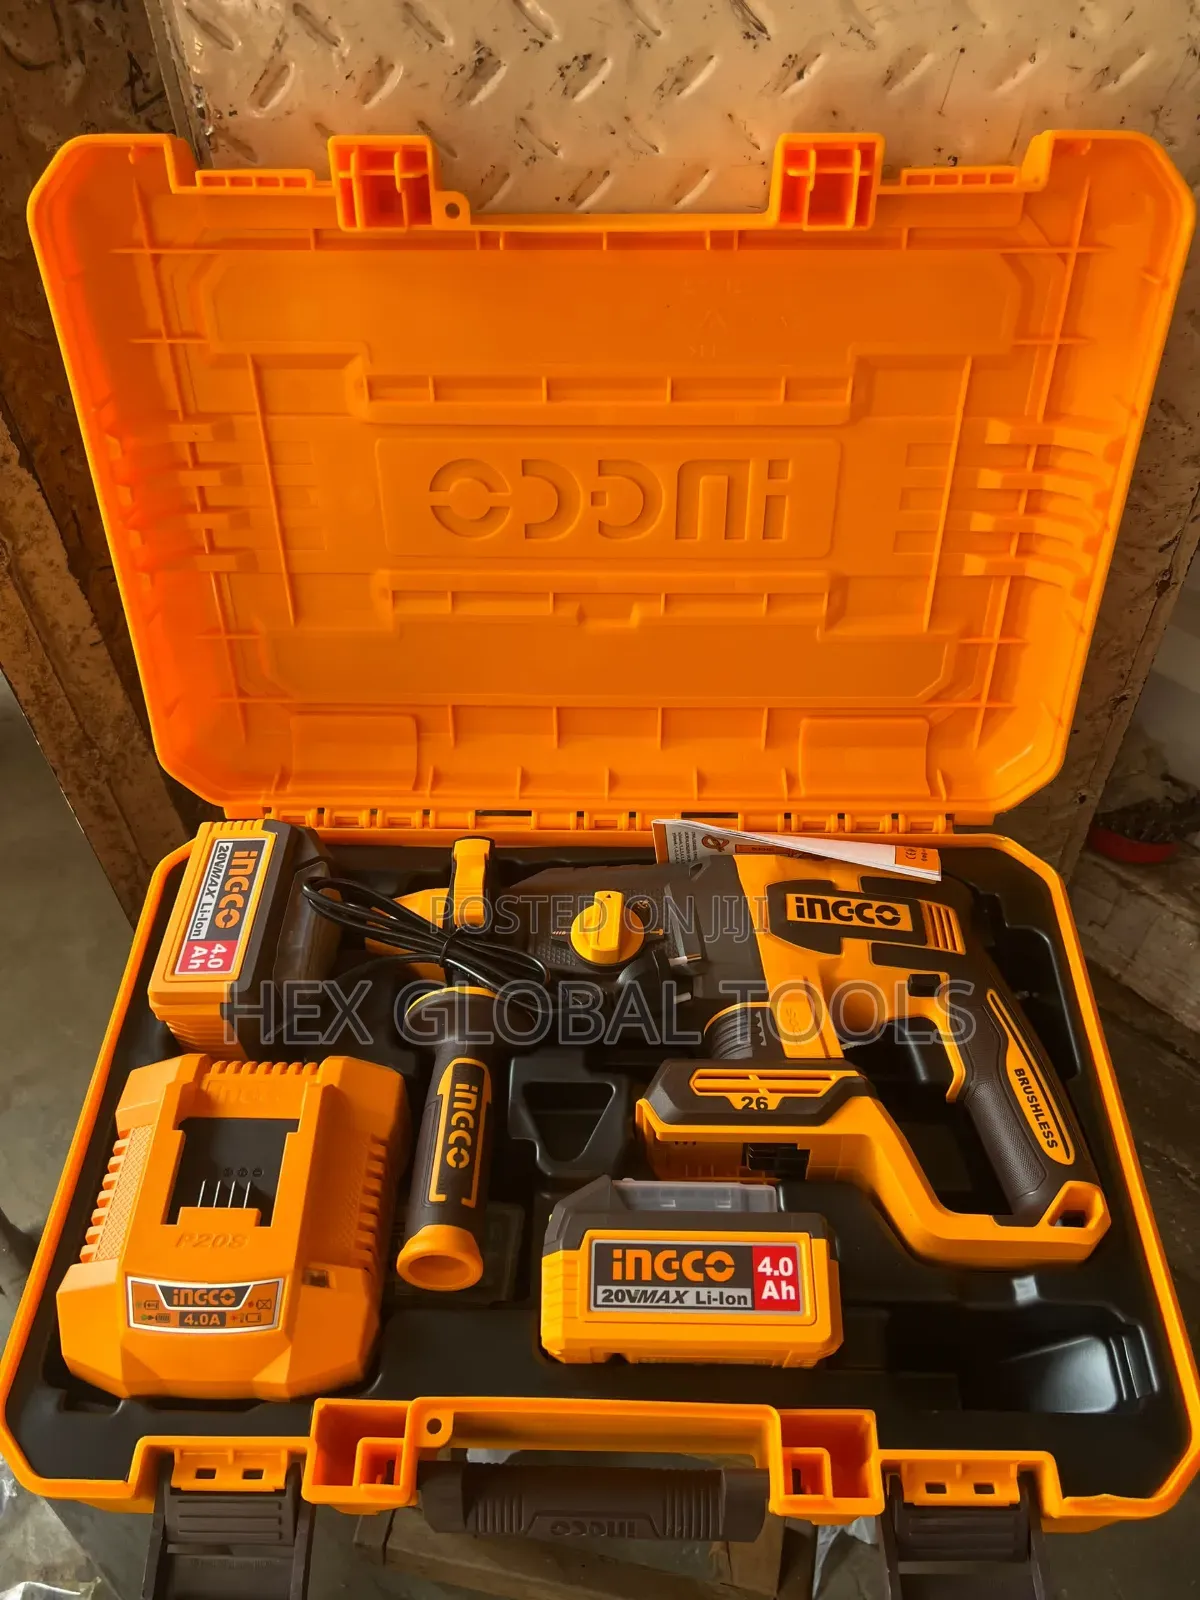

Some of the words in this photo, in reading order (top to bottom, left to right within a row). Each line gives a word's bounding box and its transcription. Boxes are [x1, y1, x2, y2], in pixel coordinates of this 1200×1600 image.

[204, 845, 230, 898] 20VMAX
[192, 902, 211, 937] Li-Ion
[187, 945, 209, 970] Ah
[209, 943, 228, 970] 4.0
[741, 1096, 768, 1112] 26
[1013, 1068, 1058, 1150] BRUSHLESS
[757, 1255, 794, 1277] 4.0
[602, 1288, 689, 1305] 20VMAX
[695, 1290, 749, 1306] Li-Ion
[761, 1279, 796, 1301] Ah
[184, 1312, 221, 1327] 4.0A
